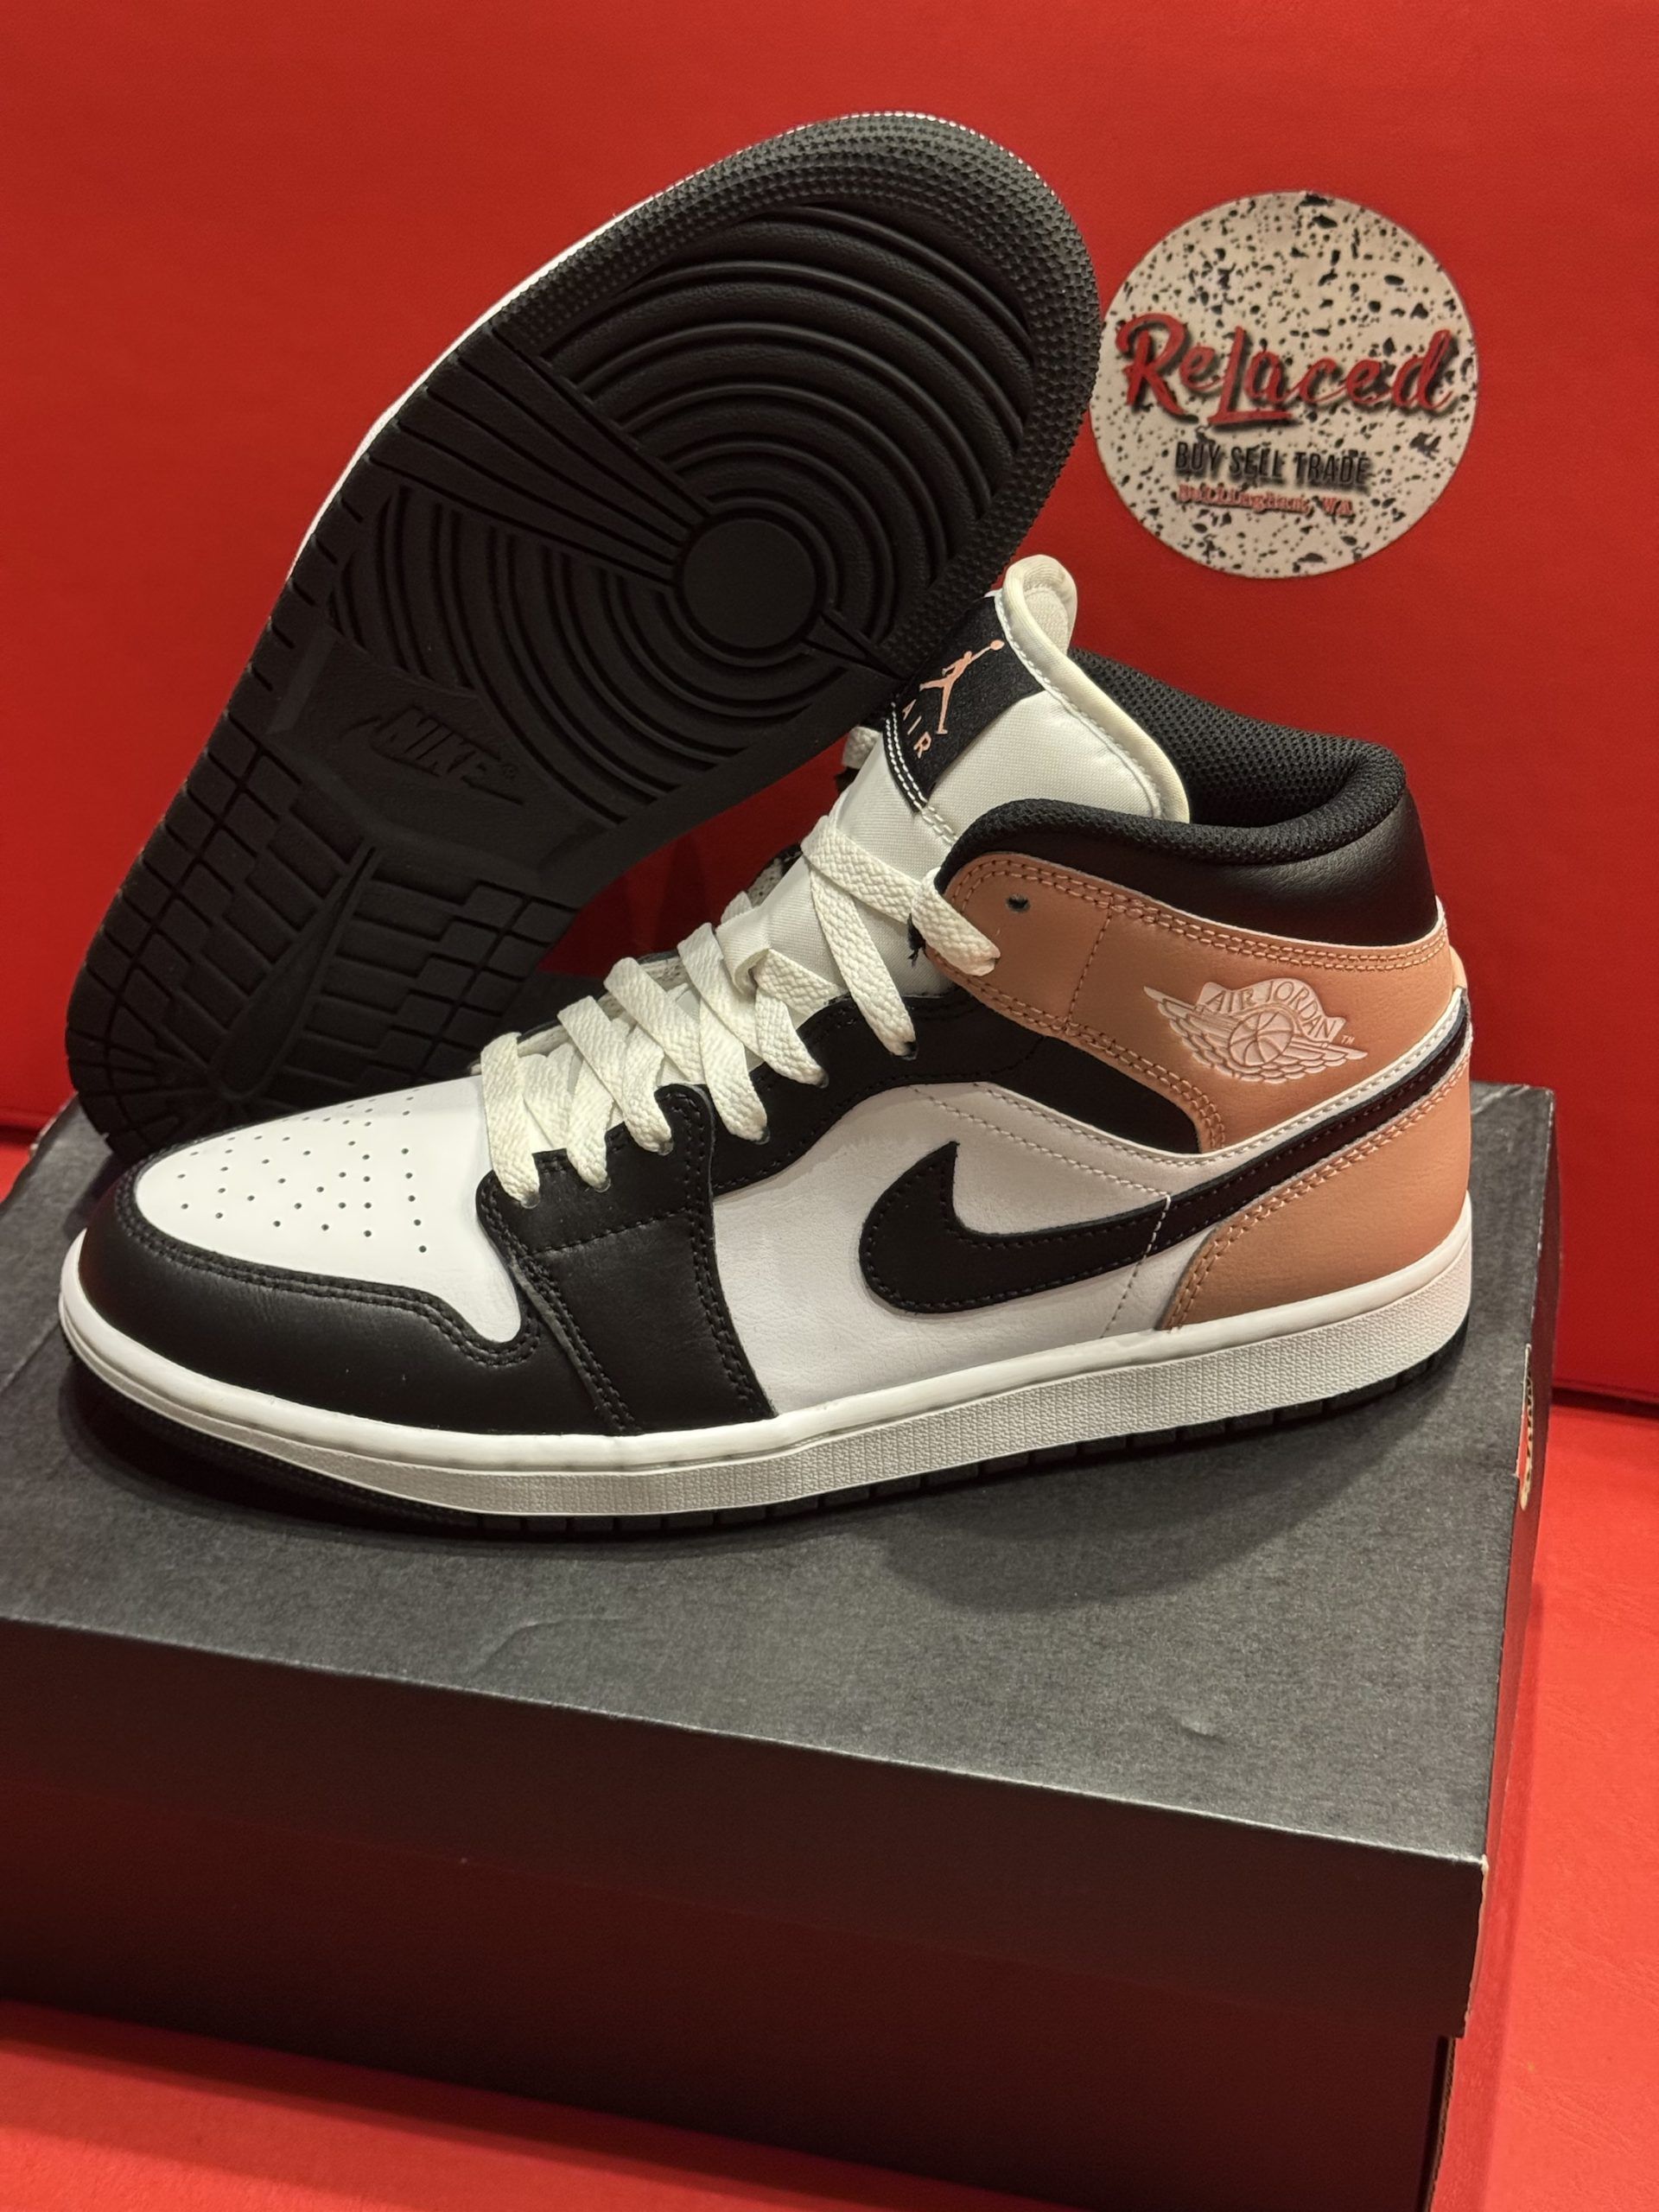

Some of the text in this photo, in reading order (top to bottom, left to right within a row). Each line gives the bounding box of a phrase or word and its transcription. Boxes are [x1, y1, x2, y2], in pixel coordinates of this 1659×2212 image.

[1116, 313, 1455, 425] ReLaced
[1175, 442, 1370, 486] BUY SELL TRADE
[1322, 497, 1354, 516] WA
[370, 702, 503, 783] NIKE
[901, 698, 932, 759] AIR
[1205, 988, 1259, 1013] AIR
[1267, 980, 1337, 1039] JORDAN
